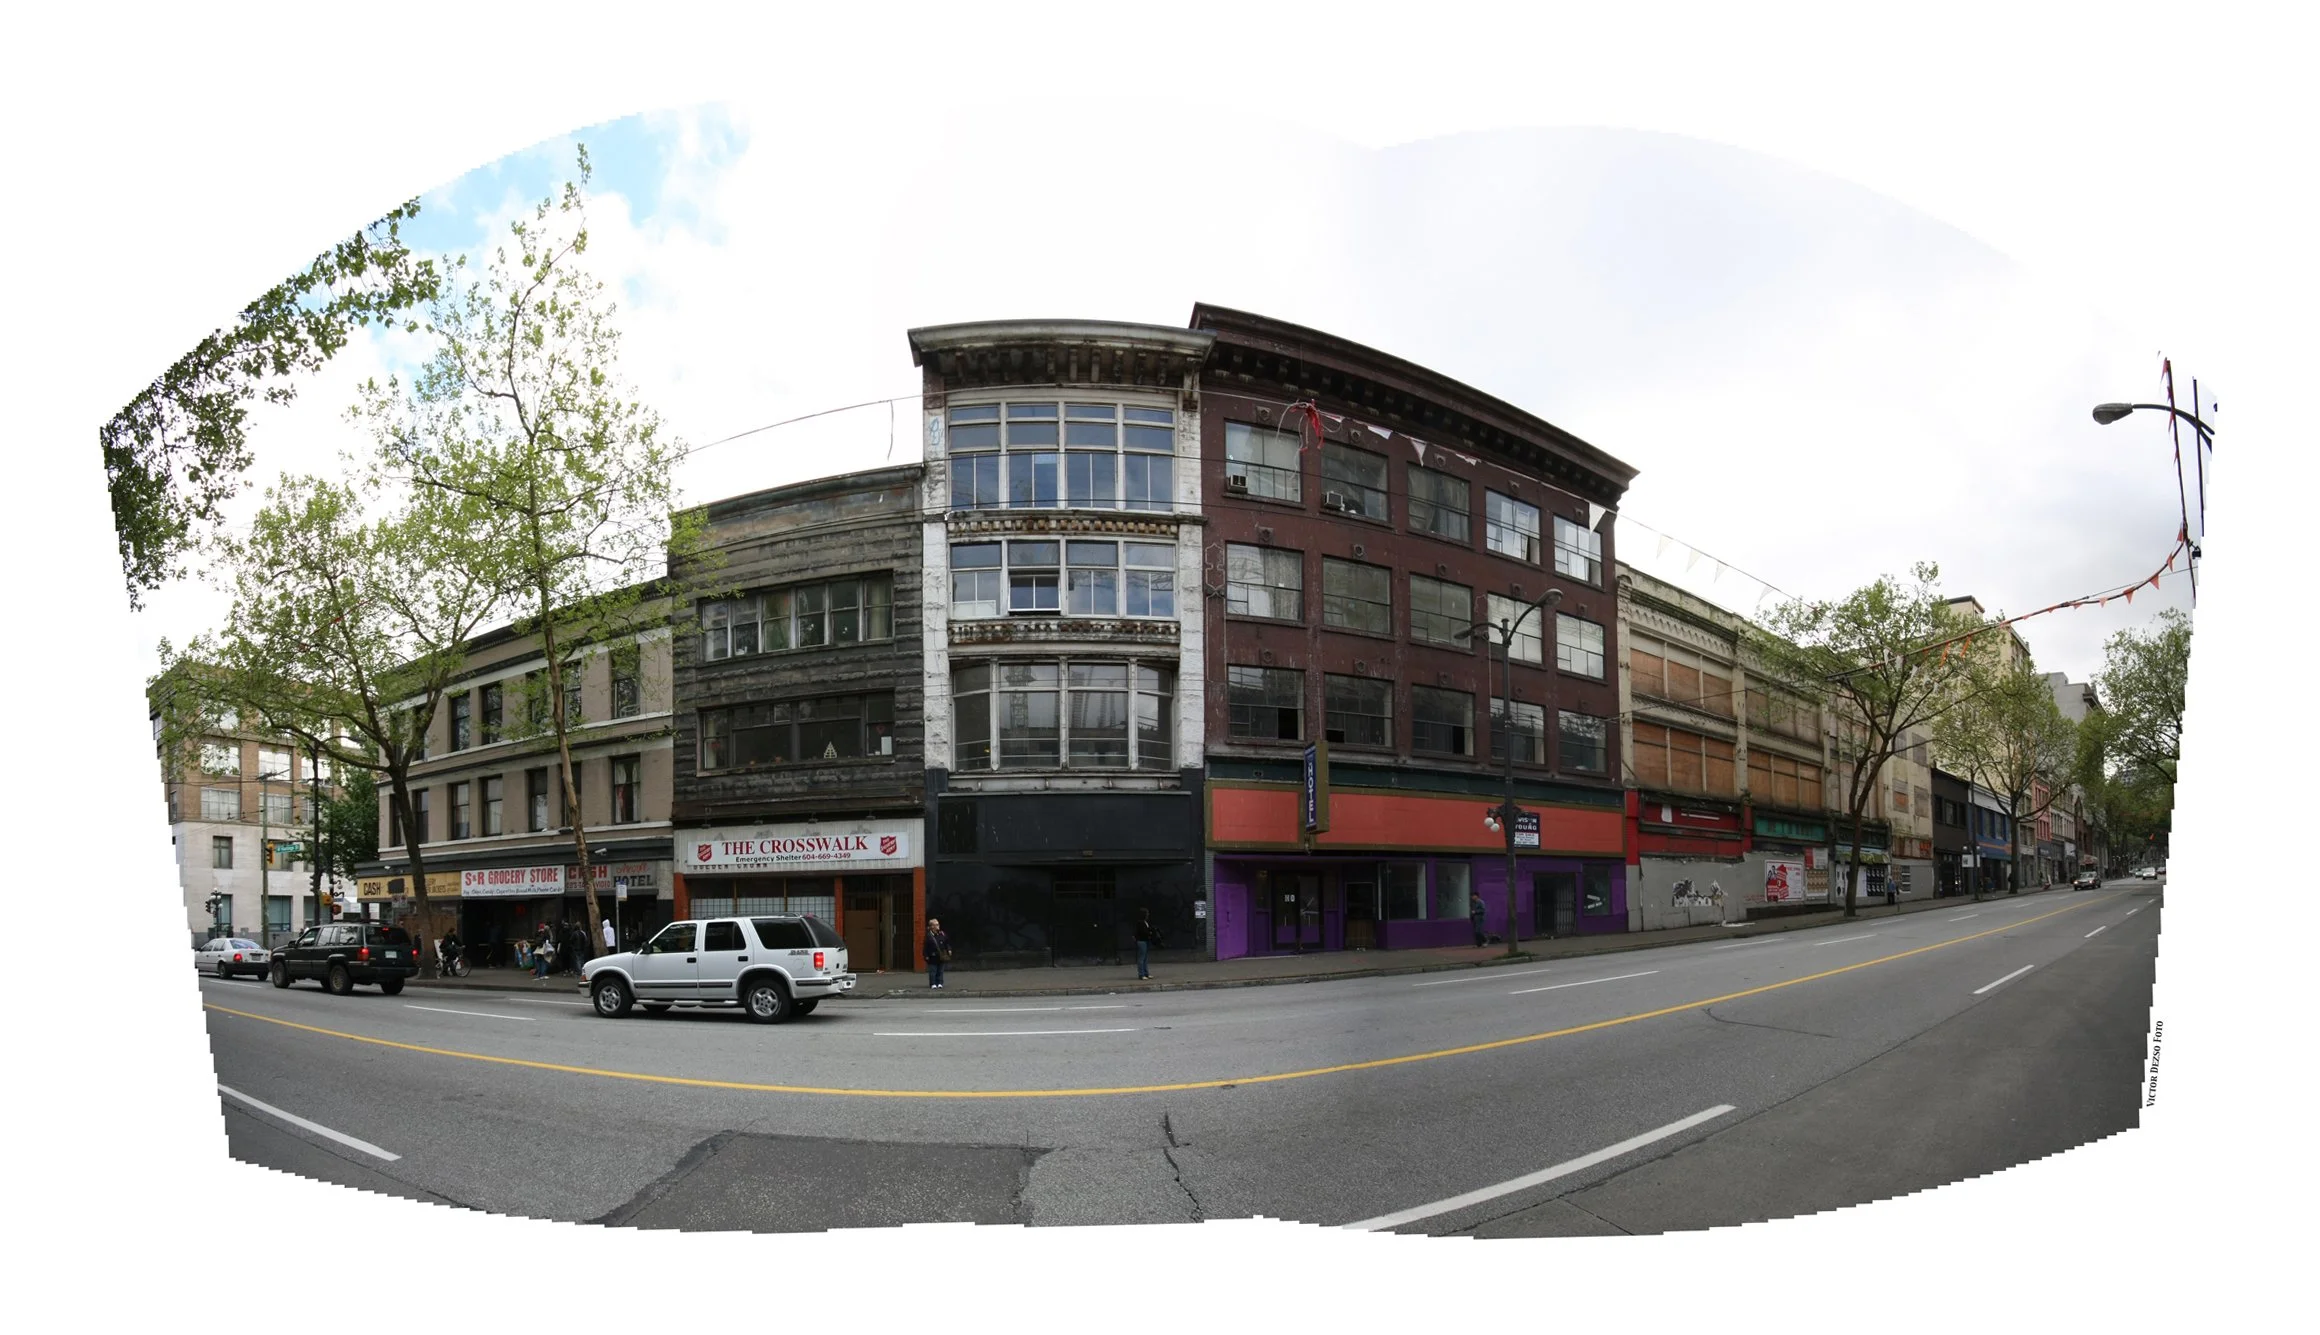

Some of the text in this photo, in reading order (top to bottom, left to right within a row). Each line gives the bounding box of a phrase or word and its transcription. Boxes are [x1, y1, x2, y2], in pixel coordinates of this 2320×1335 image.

[1307, 762, 1315, 823] HOTEL
[722, 840, 755, 856] THE
[759, 835, 869, 855] CROSSWALK
[735, 852, 851, 863] Emergency Shelter 604-669-4349
[488, 869, 526, 885] GROCERY
[530, 867, 559, 883] STORE
[613, 874, 654, 888] HOTEL
[363, 882, 381, 896] CASH
